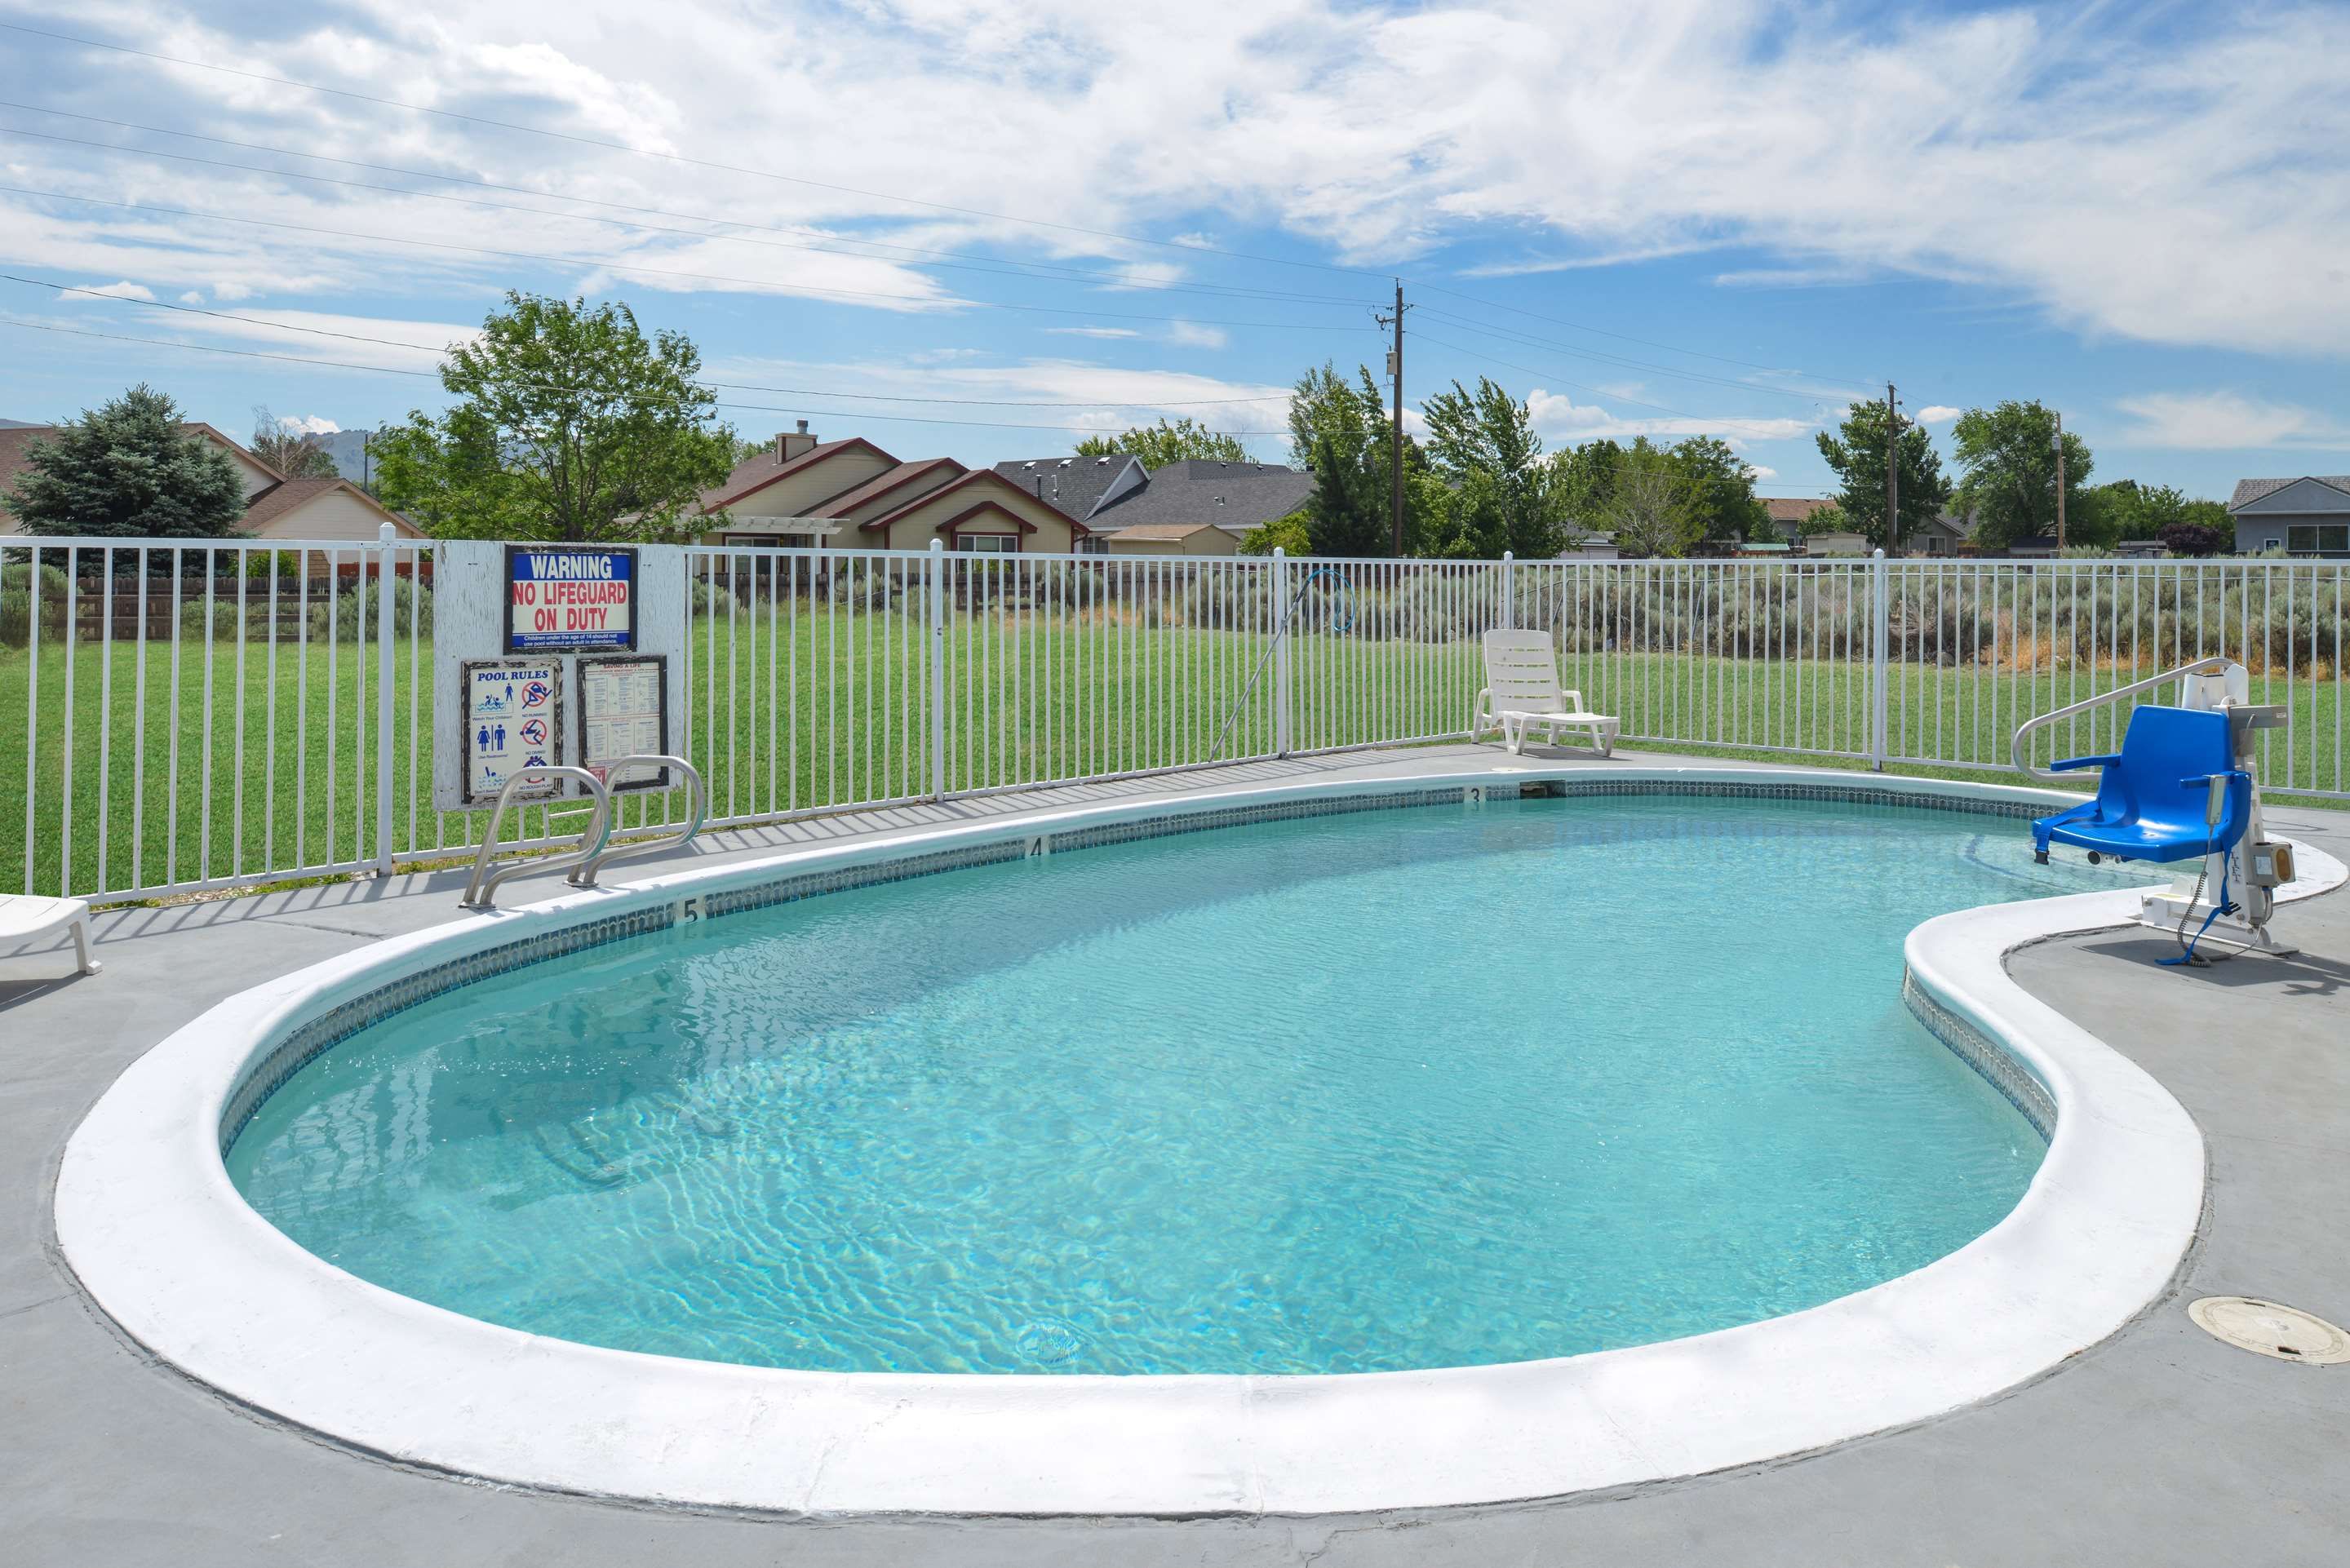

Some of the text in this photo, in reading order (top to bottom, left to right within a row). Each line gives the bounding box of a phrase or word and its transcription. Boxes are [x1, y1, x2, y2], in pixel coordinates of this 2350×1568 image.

[530, 556, 612, 579] WARNING
[512, 582, 627, 605] NO LIFEGUARD
[534, 607, 608, 631] ON DUTY
[477, 670, 548, 681] POOL RULES
[1470, 788, 1479, 802] 3
[1030, 837, 1041, 856] 4
[685, 898, 698, 924] 5
